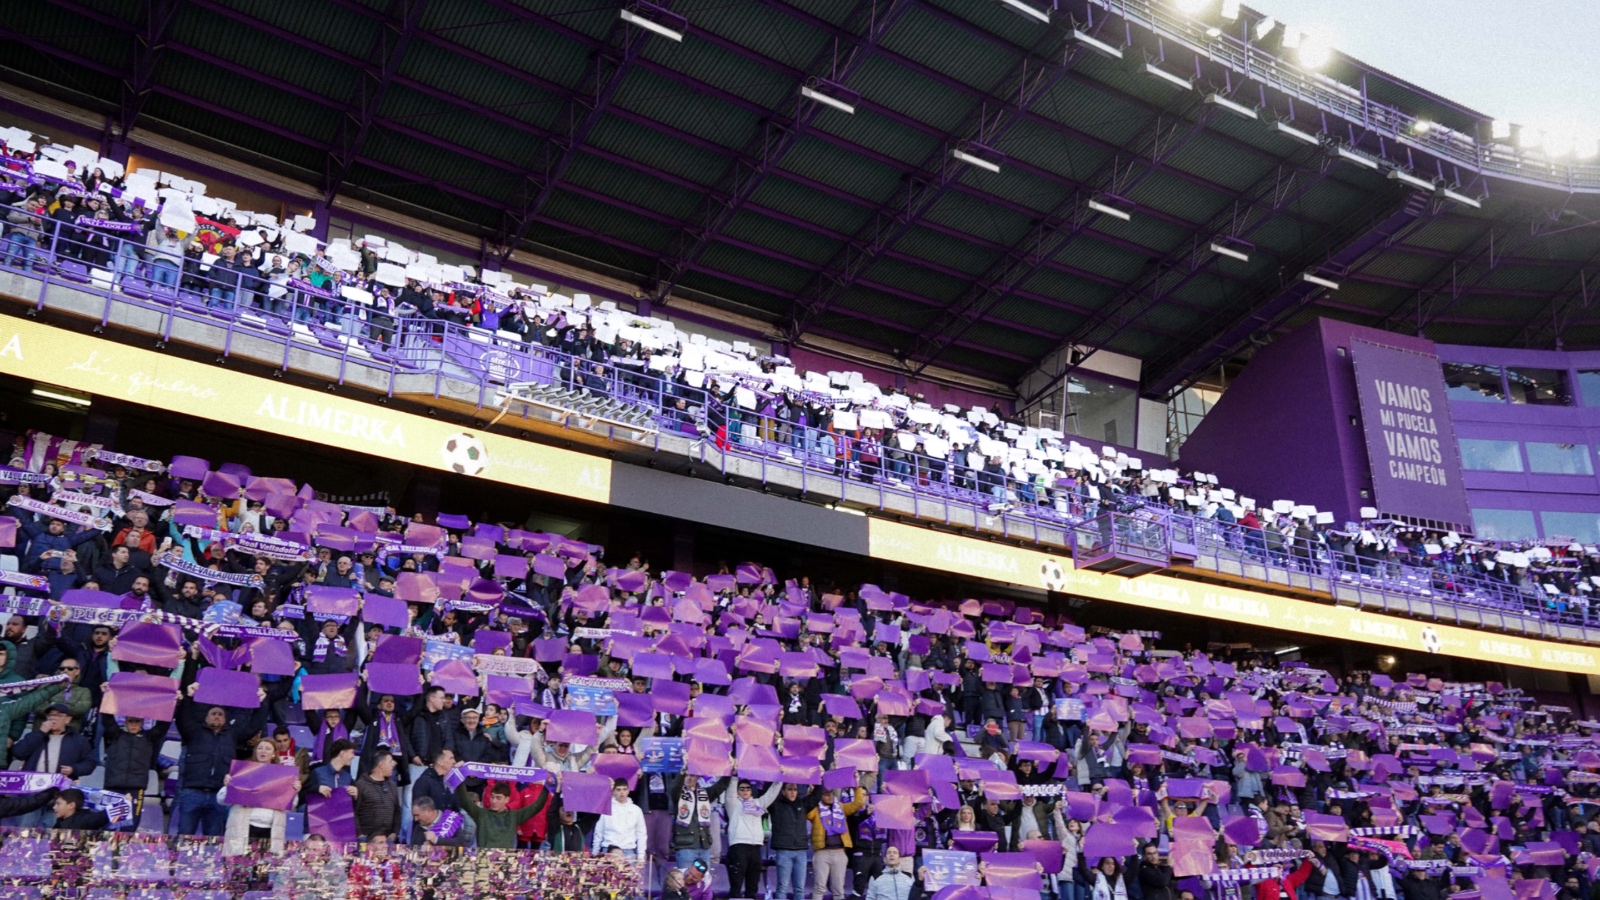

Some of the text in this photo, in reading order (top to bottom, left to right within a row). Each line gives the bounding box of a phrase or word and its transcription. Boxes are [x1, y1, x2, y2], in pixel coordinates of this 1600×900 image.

[1375, 379, 1432, 413] VAMOS
[256, 394, 407, 448] ALIMERKA
[1380, 409, 1438, 435] MI PUCELA
[1384, 430, 1442, 464] VAMOS
[1389, 459, 1447, 486] CAMPEÓN
[28, 500, 89, 520] REAL VALLADOLID
[239, 539, 300, 555] Real Valladolid
[936, 543, 1019, 574] ALIMERKA
[73, 608, 138, 622] PUCELA
[1118, 578, 1191, 605] ALIMERKA
[1202, 592, 1270, 619] ALIMERKA
[1350, 617, 1409, 641] ALIMERKA
[468, 765, 535, 777] REAL VALLADOLID
